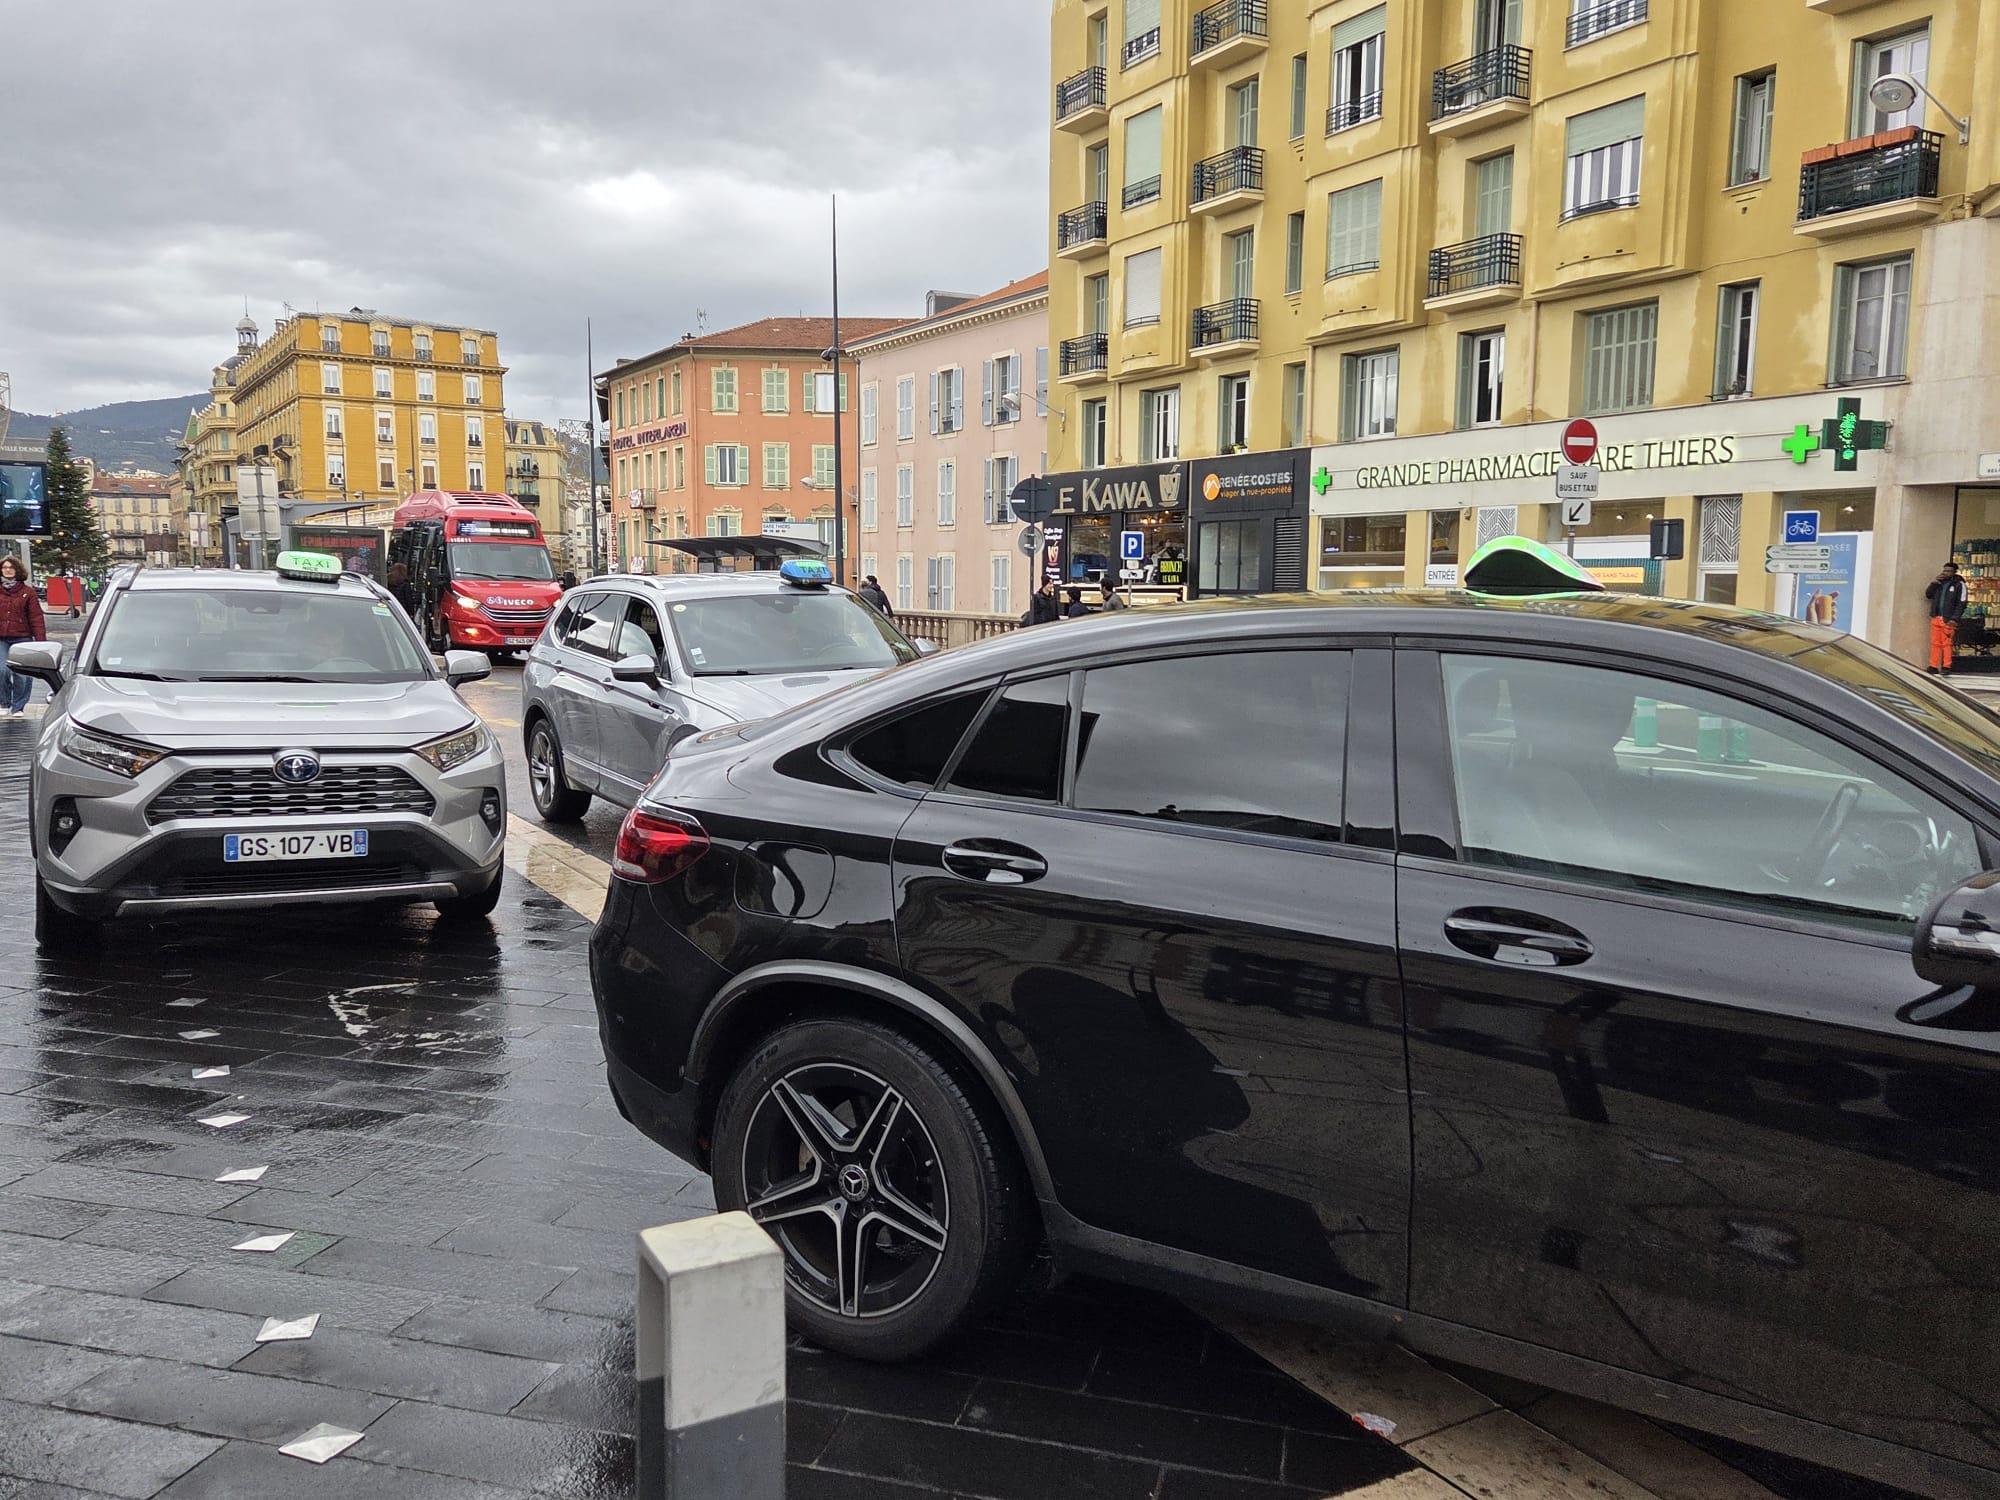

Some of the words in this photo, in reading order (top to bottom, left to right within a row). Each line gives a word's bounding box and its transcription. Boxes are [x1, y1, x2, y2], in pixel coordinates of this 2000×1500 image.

[612, 434, 636, 451] HOTEL
[637, 421, 687, 445] INTERLAKEN
[1356, 461, 1431, 489] GRANDE
[1438, 450, 1561, 484] PHARMACIE
[1588, 444, 1635, 472] ARE
[1643, 435, 1735, 469] THIERS
[1219, 473, 1250, 488] RENÉE
[1250, 471, 1291, 486] COSTES
[1570, 471, 1588, 480] SAUF
[1221, 489, 1240, 499] viager
[1559, 484, 1572, 492] BUS
[1573, 484, 1582, 492] ET
[1583, 484, 1597, 492] TAXI
[1081, 477, 1154, 513] KAWA
[1128, 537, 1138, 555] P
[292, 557, 330, 569] TAXI
[1160, 560, 1183, 573] BRUNCH
[800, 566, 827, 575] TAXI
[1428, 569, 1456, 580] ENTRÉE
[240, 834, 353, 857] GS-107-VB
[355, 844, 365, 853] 06
